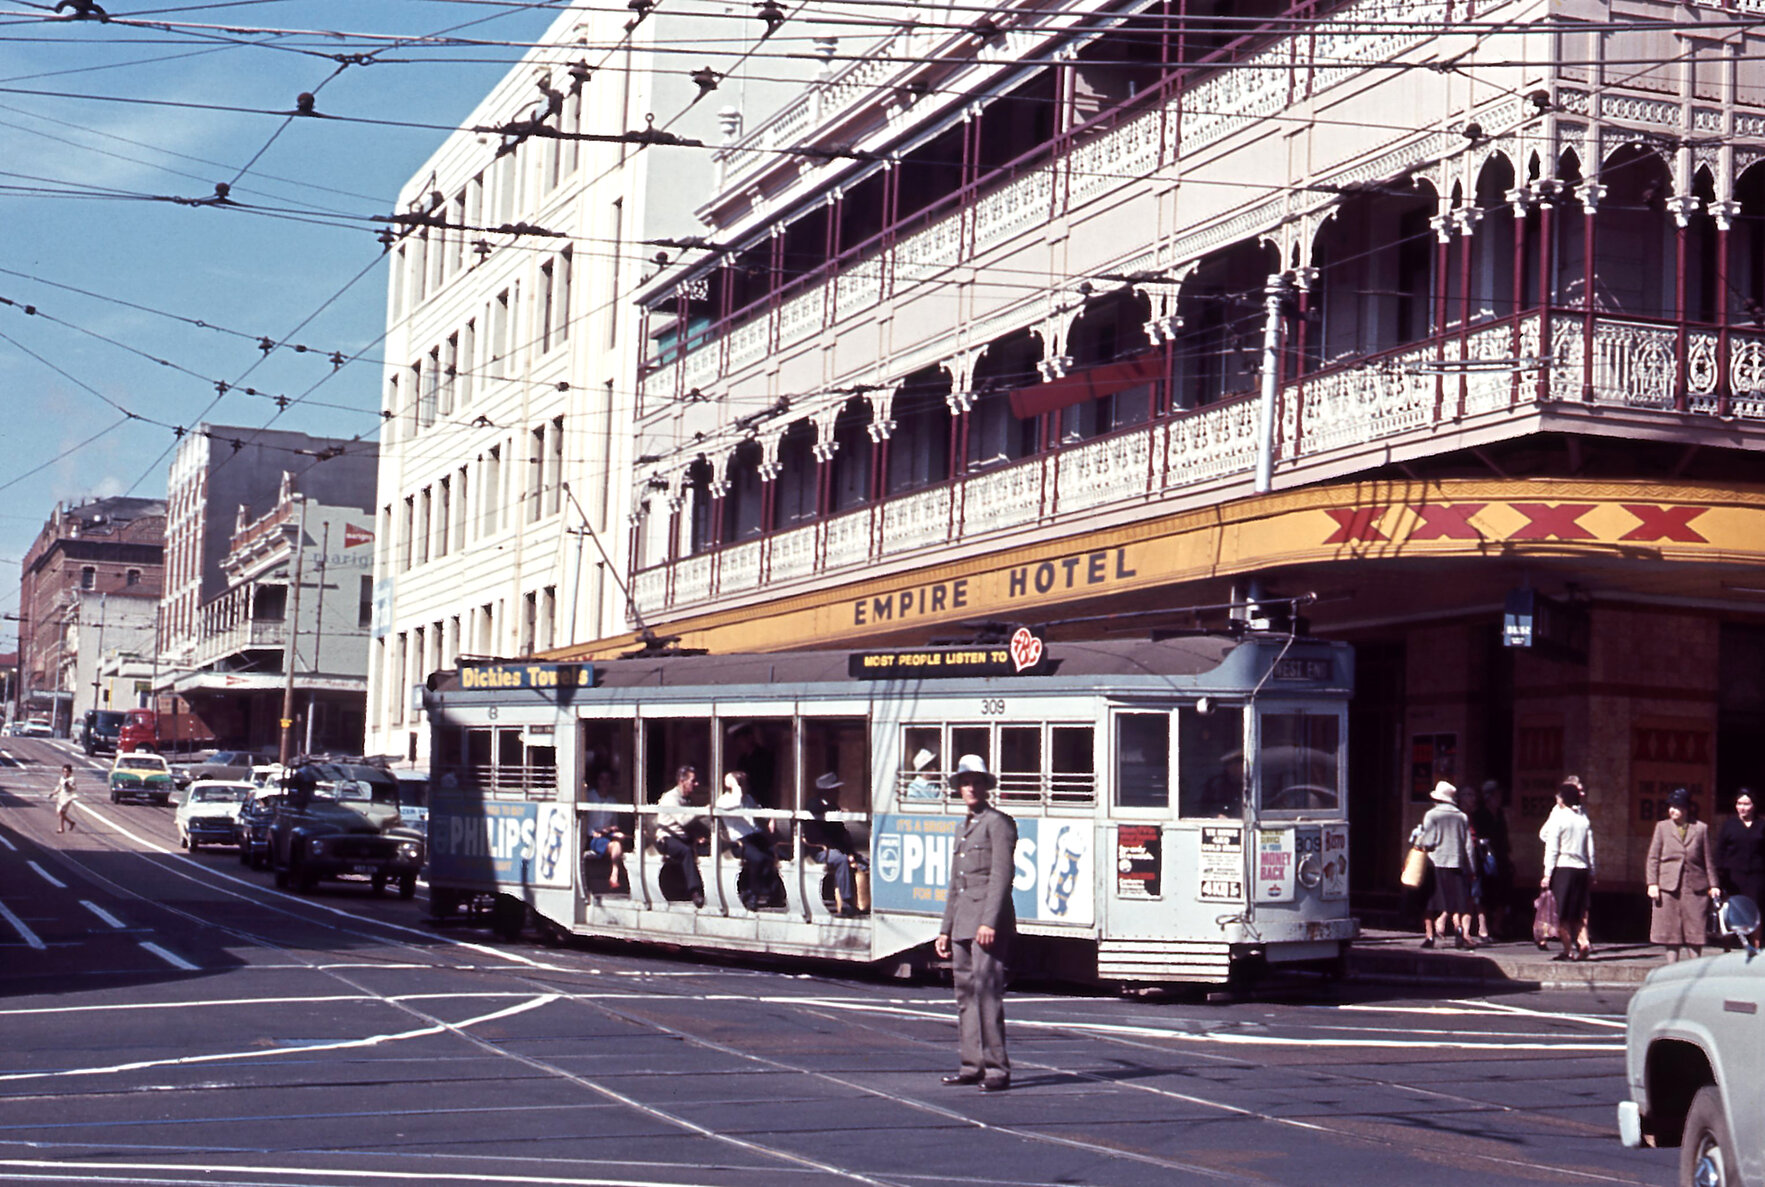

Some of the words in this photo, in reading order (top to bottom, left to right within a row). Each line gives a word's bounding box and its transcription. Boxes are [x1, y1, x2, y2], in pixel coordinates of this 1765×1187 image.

[1322, 502, 1710, 544] XXXX
[854, 580, 968, 625] EMPIRE
[1009, 548, 1136, 598] HOTEL
[864, 656, 895, 667] MOST
[898, 653, 941, 666] PEOPLE
[945, 651, 987, 665] LISTEN
[990, 651, 1008, 663] TO
[462, 667, 521, 687] Dickies
[526, 667, 589, 686] Towels
[1274, 660, 1303, 677] WEST
[981, 699, 1006, 714] 309
[450, 816, 536, 860] PHILIPS
[1295, 836, 1321, 853] 309
[1260, 852, 1292, 866] MONEY
[1260, 867, 1285, 881] BACK
